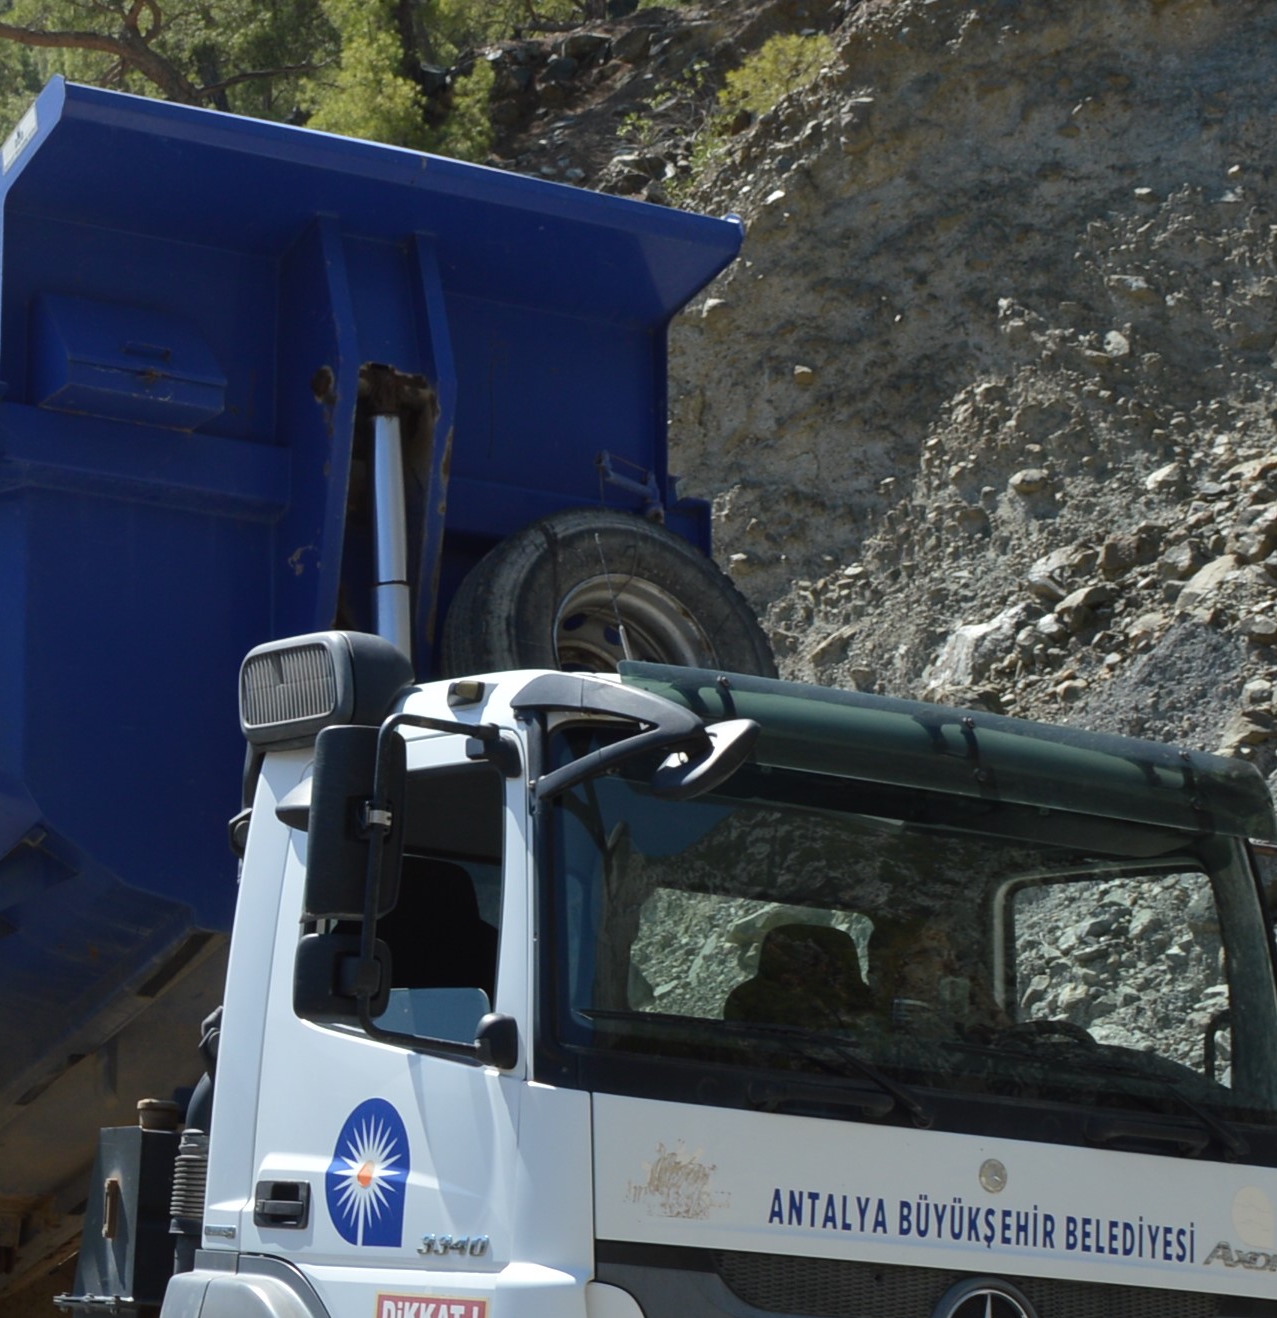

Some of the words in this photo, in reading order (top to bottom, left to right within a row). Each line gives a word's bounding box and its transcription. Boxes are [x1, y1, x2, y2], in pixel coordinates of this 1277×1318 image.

[417, 1233, 489, 1257] 3340
[768, 1188, 888, 1234] ANTALYA
[899, 1194, 1055, 1249] BÜYÜKŞEHİR
[1065, 1215, 1195, 1263] BELEDİYESİ
